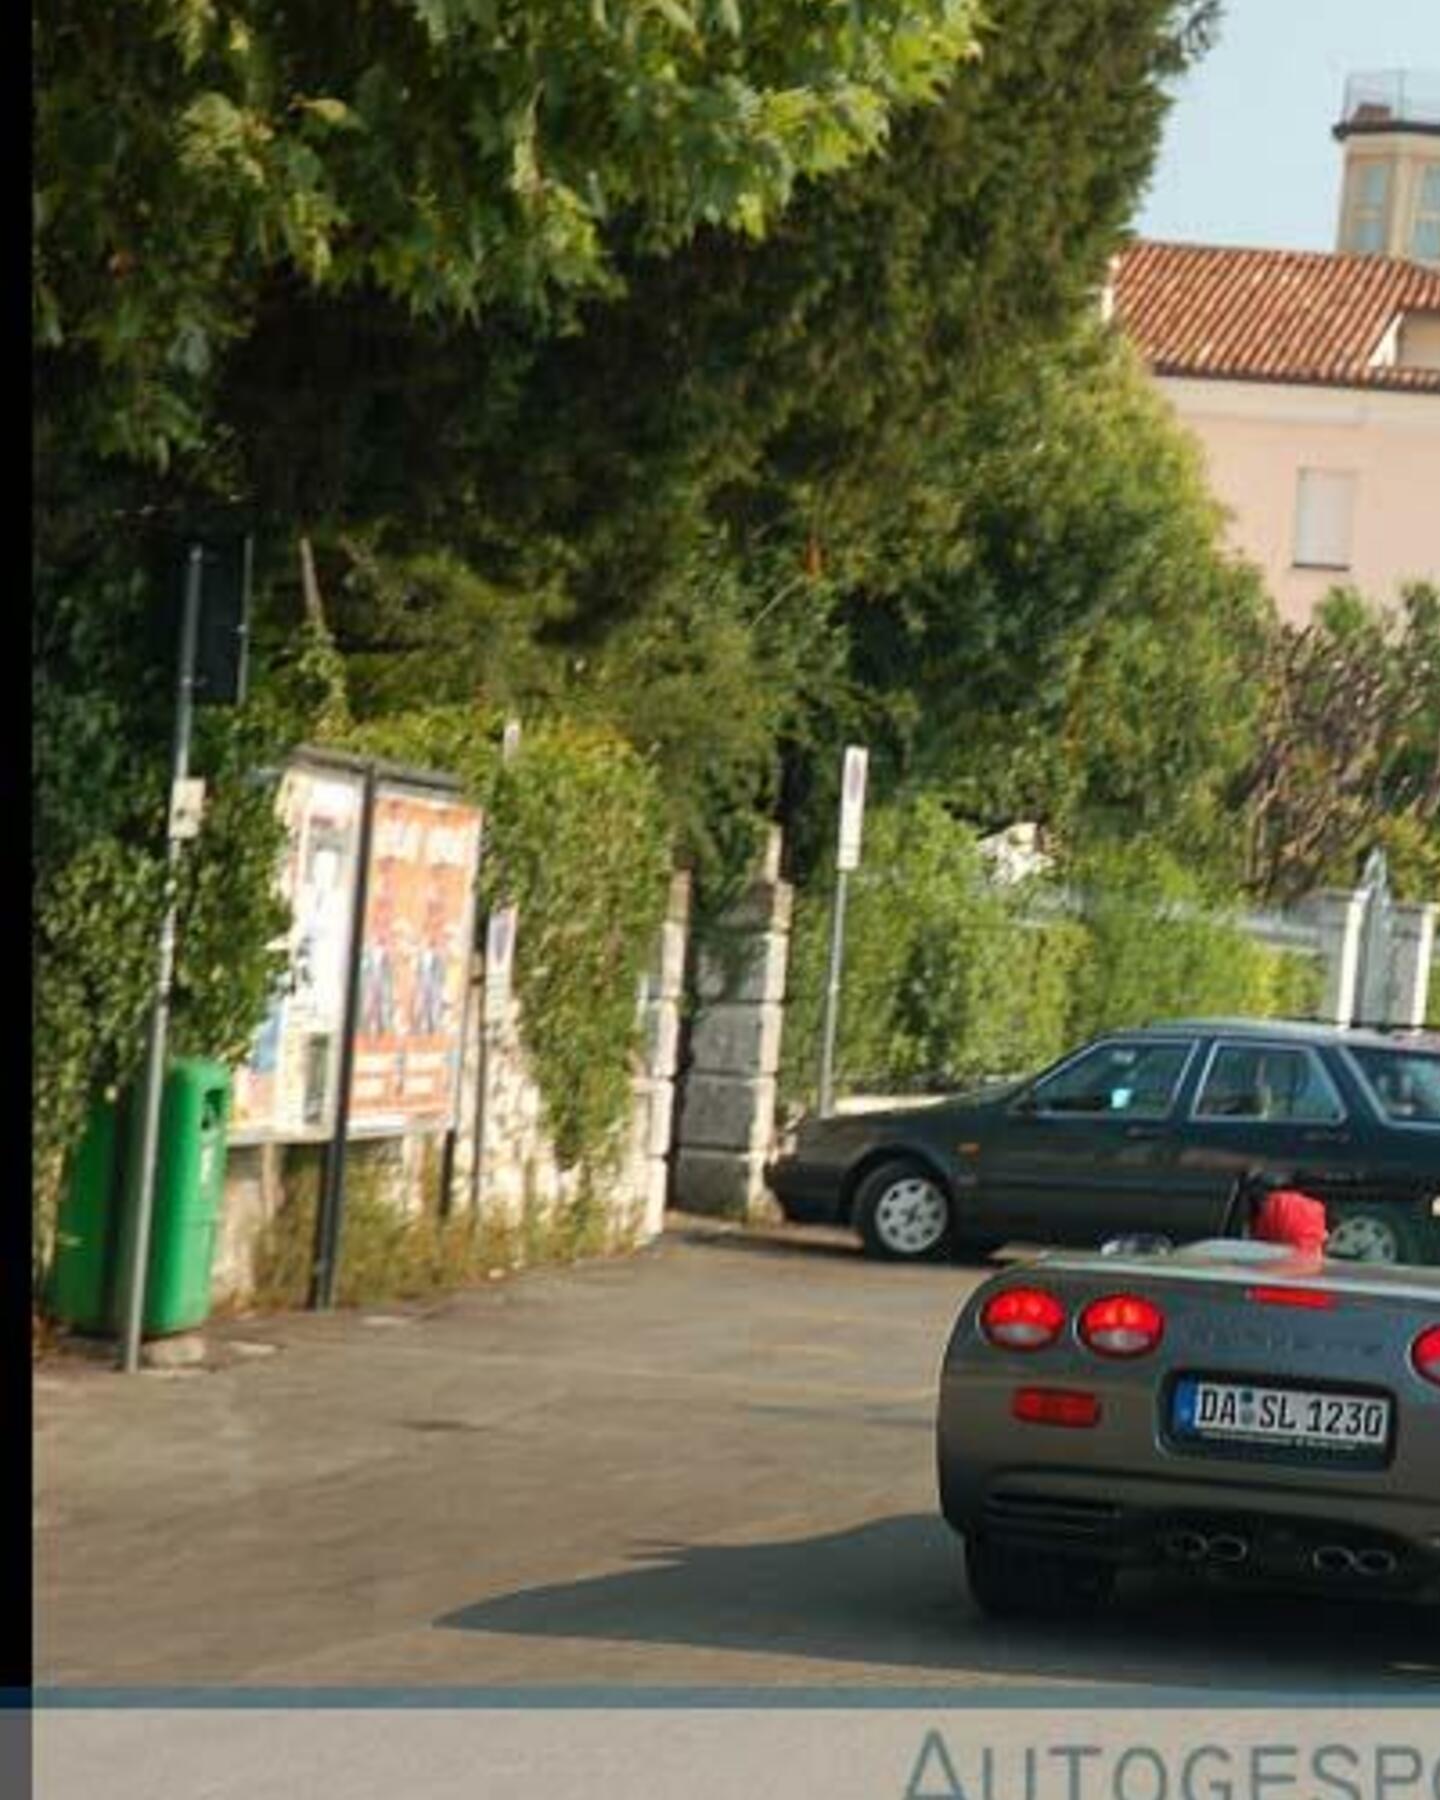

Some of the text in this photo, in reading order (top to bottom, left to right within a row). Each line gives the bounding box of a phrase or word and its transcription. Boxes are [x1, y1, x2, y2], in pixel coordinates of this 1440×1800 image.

[1199, 1390, 1385, 1438] DA SL 1230
